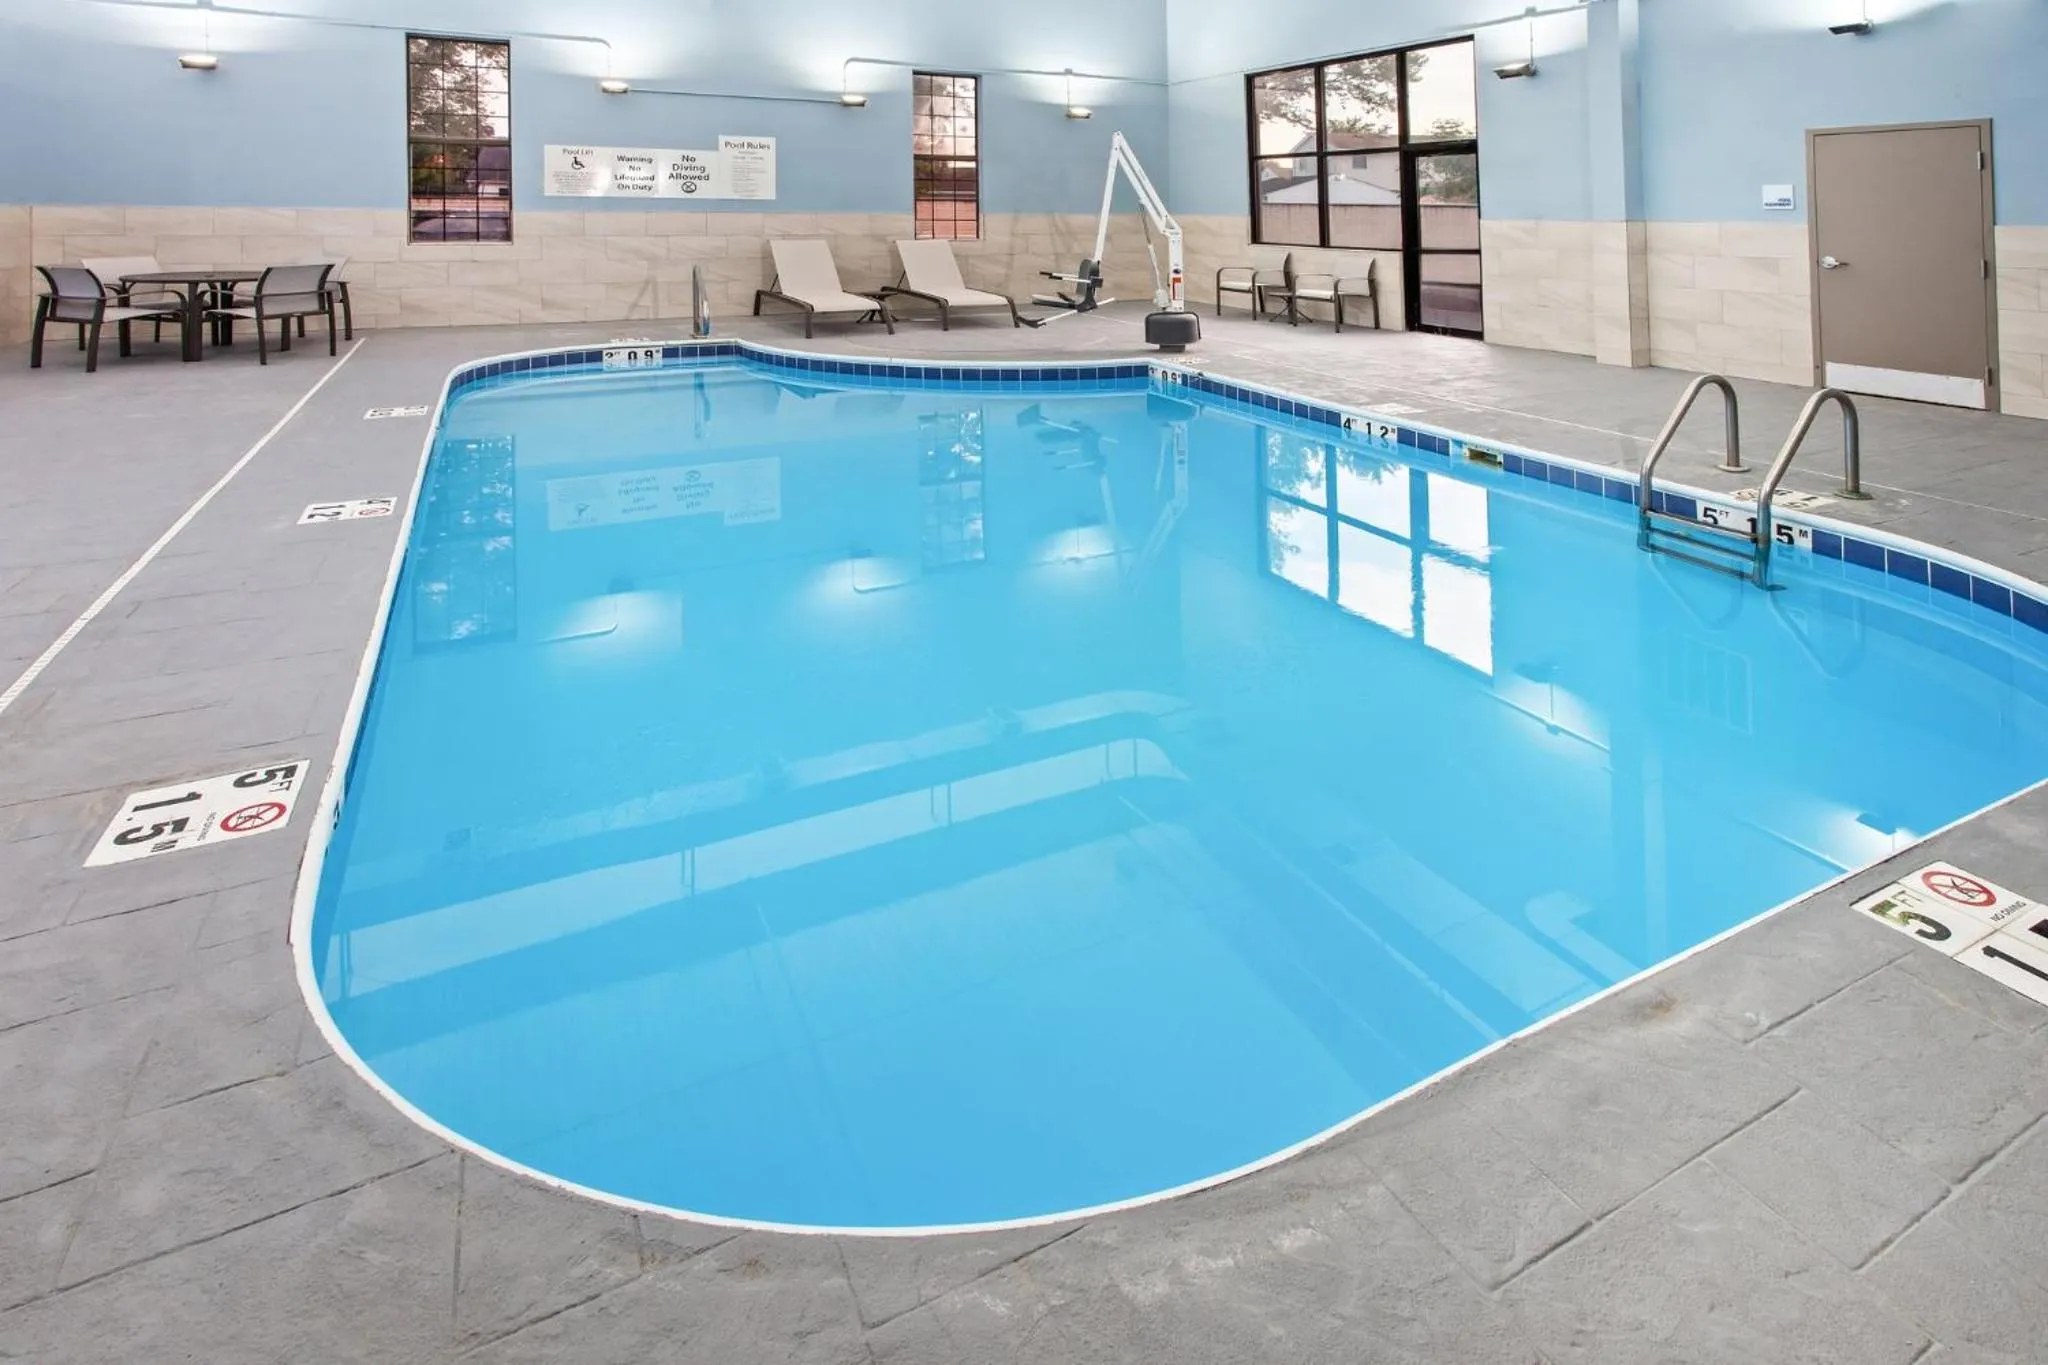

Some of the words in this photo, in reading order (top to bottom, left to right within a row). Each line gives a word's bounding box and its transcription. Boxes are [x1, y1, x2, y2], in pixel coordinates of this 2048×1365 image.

[724, 141, 745, 149] Pool
[747, 142, 771, 150] Rules
[616, 155, 653, 164] Warning
[681, 154, 696, 163] No
[672, 163, 706, 174] Diving
[668, 173, 710, 181] Allowed
[1343, 417, 1352, 430] 4
[1703, 506, 1719, 526] 5
[1719, 510, 1730, 519] FT
[1800, 529, 1808, 539] M
[233, 764, 298, 788] 5
[1868, 899, 1952, 941] 5
